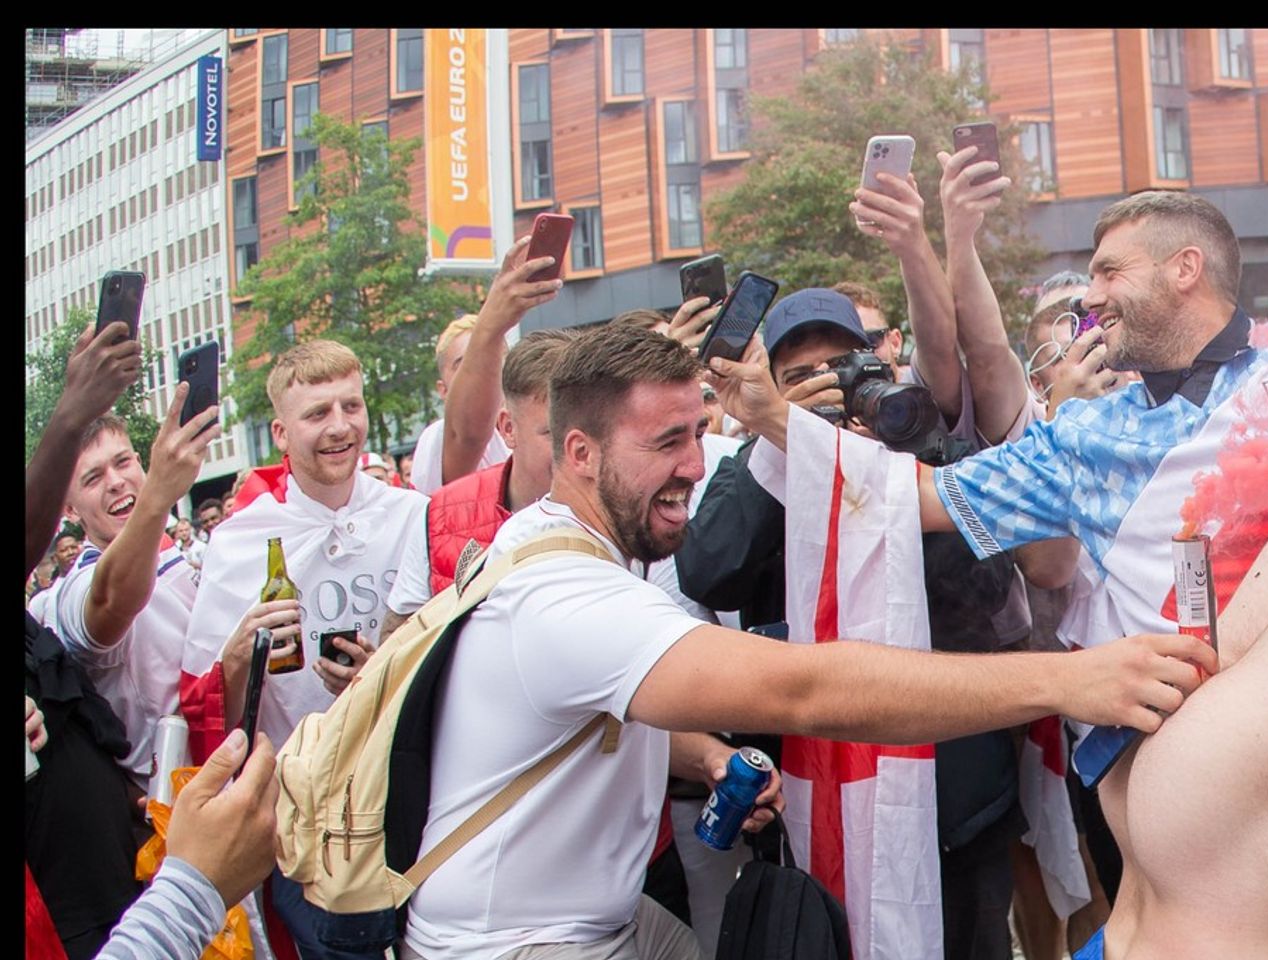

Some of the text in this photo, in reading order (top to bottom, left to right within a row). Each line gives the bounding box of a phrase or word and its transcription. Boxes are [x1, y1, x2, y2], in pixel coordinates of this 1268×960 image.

[204, 63, 219, 146] NOVOTEL
[449, 46, 467, 123] EURO
[451, 127, 469, 201] UEFA
